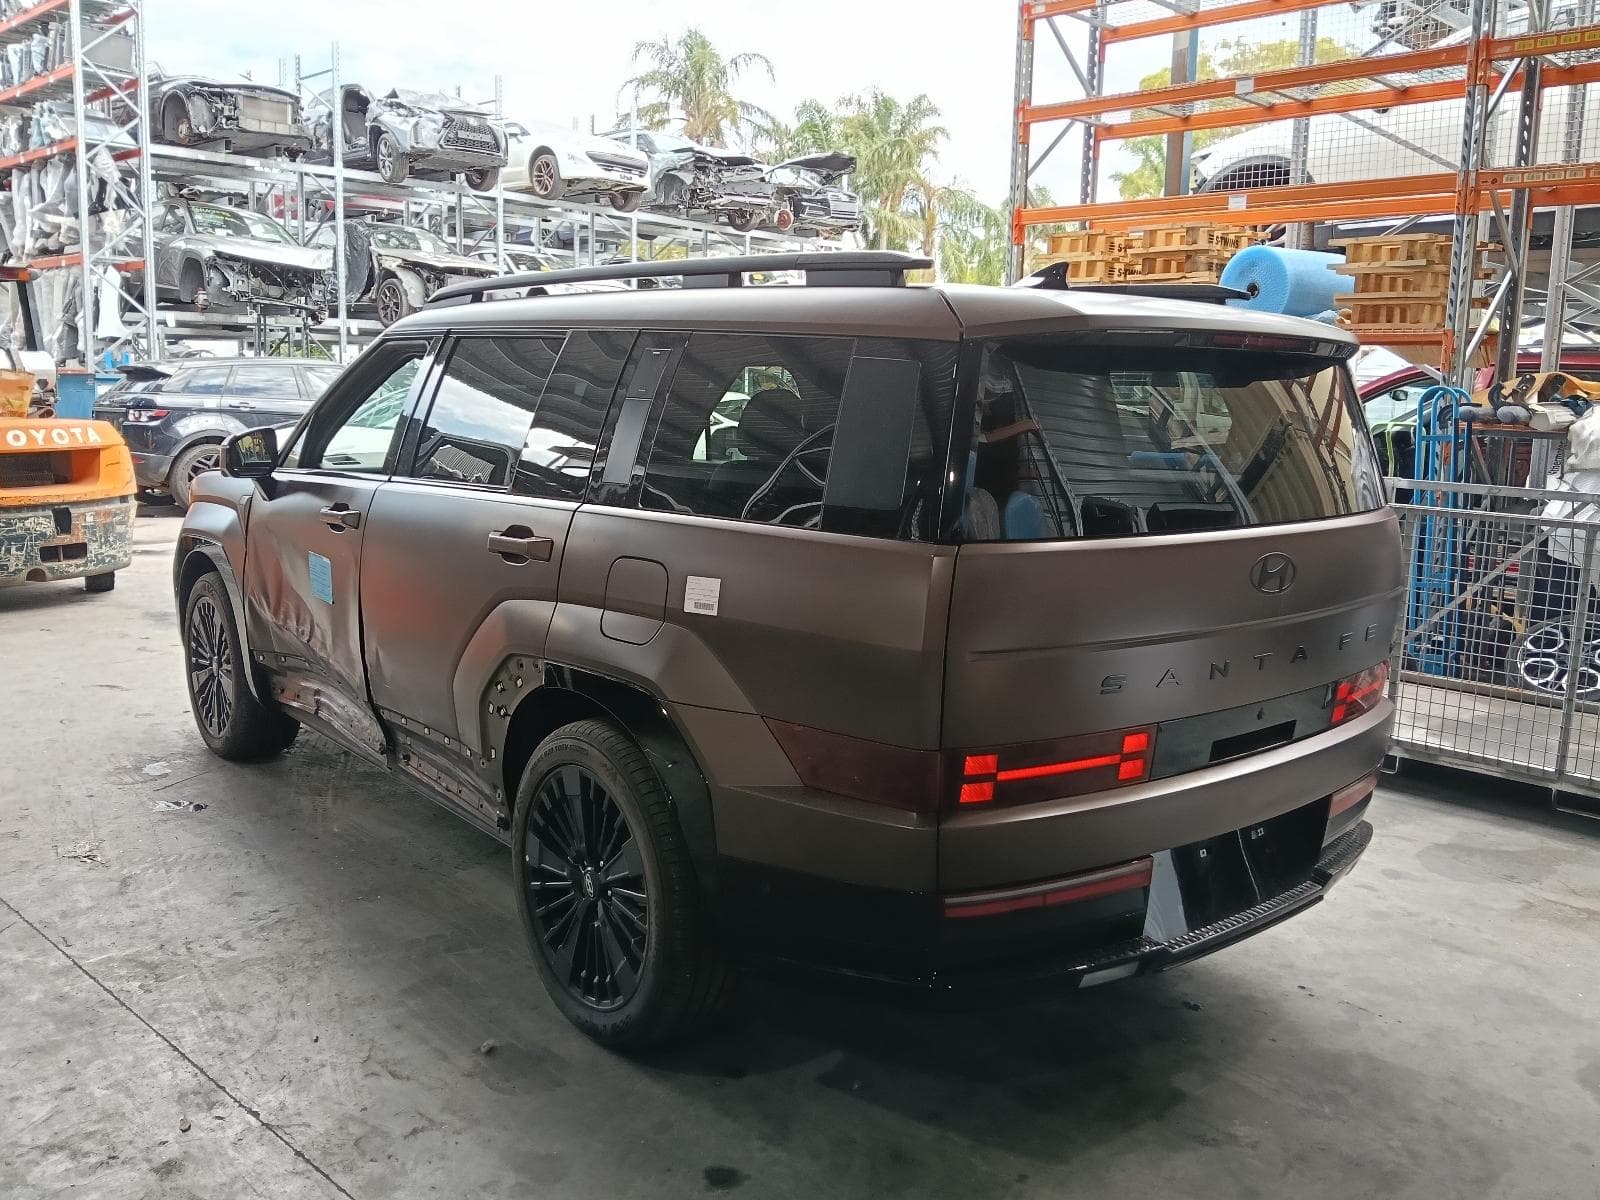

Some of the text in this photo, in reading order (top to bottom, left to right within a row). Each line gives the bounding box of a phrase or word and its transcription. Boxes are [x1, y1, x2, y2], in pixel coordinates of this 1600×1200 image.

[0, 427, 102, 447] OYOTA
[1100, 624, 1377, 695] SANTA FE
